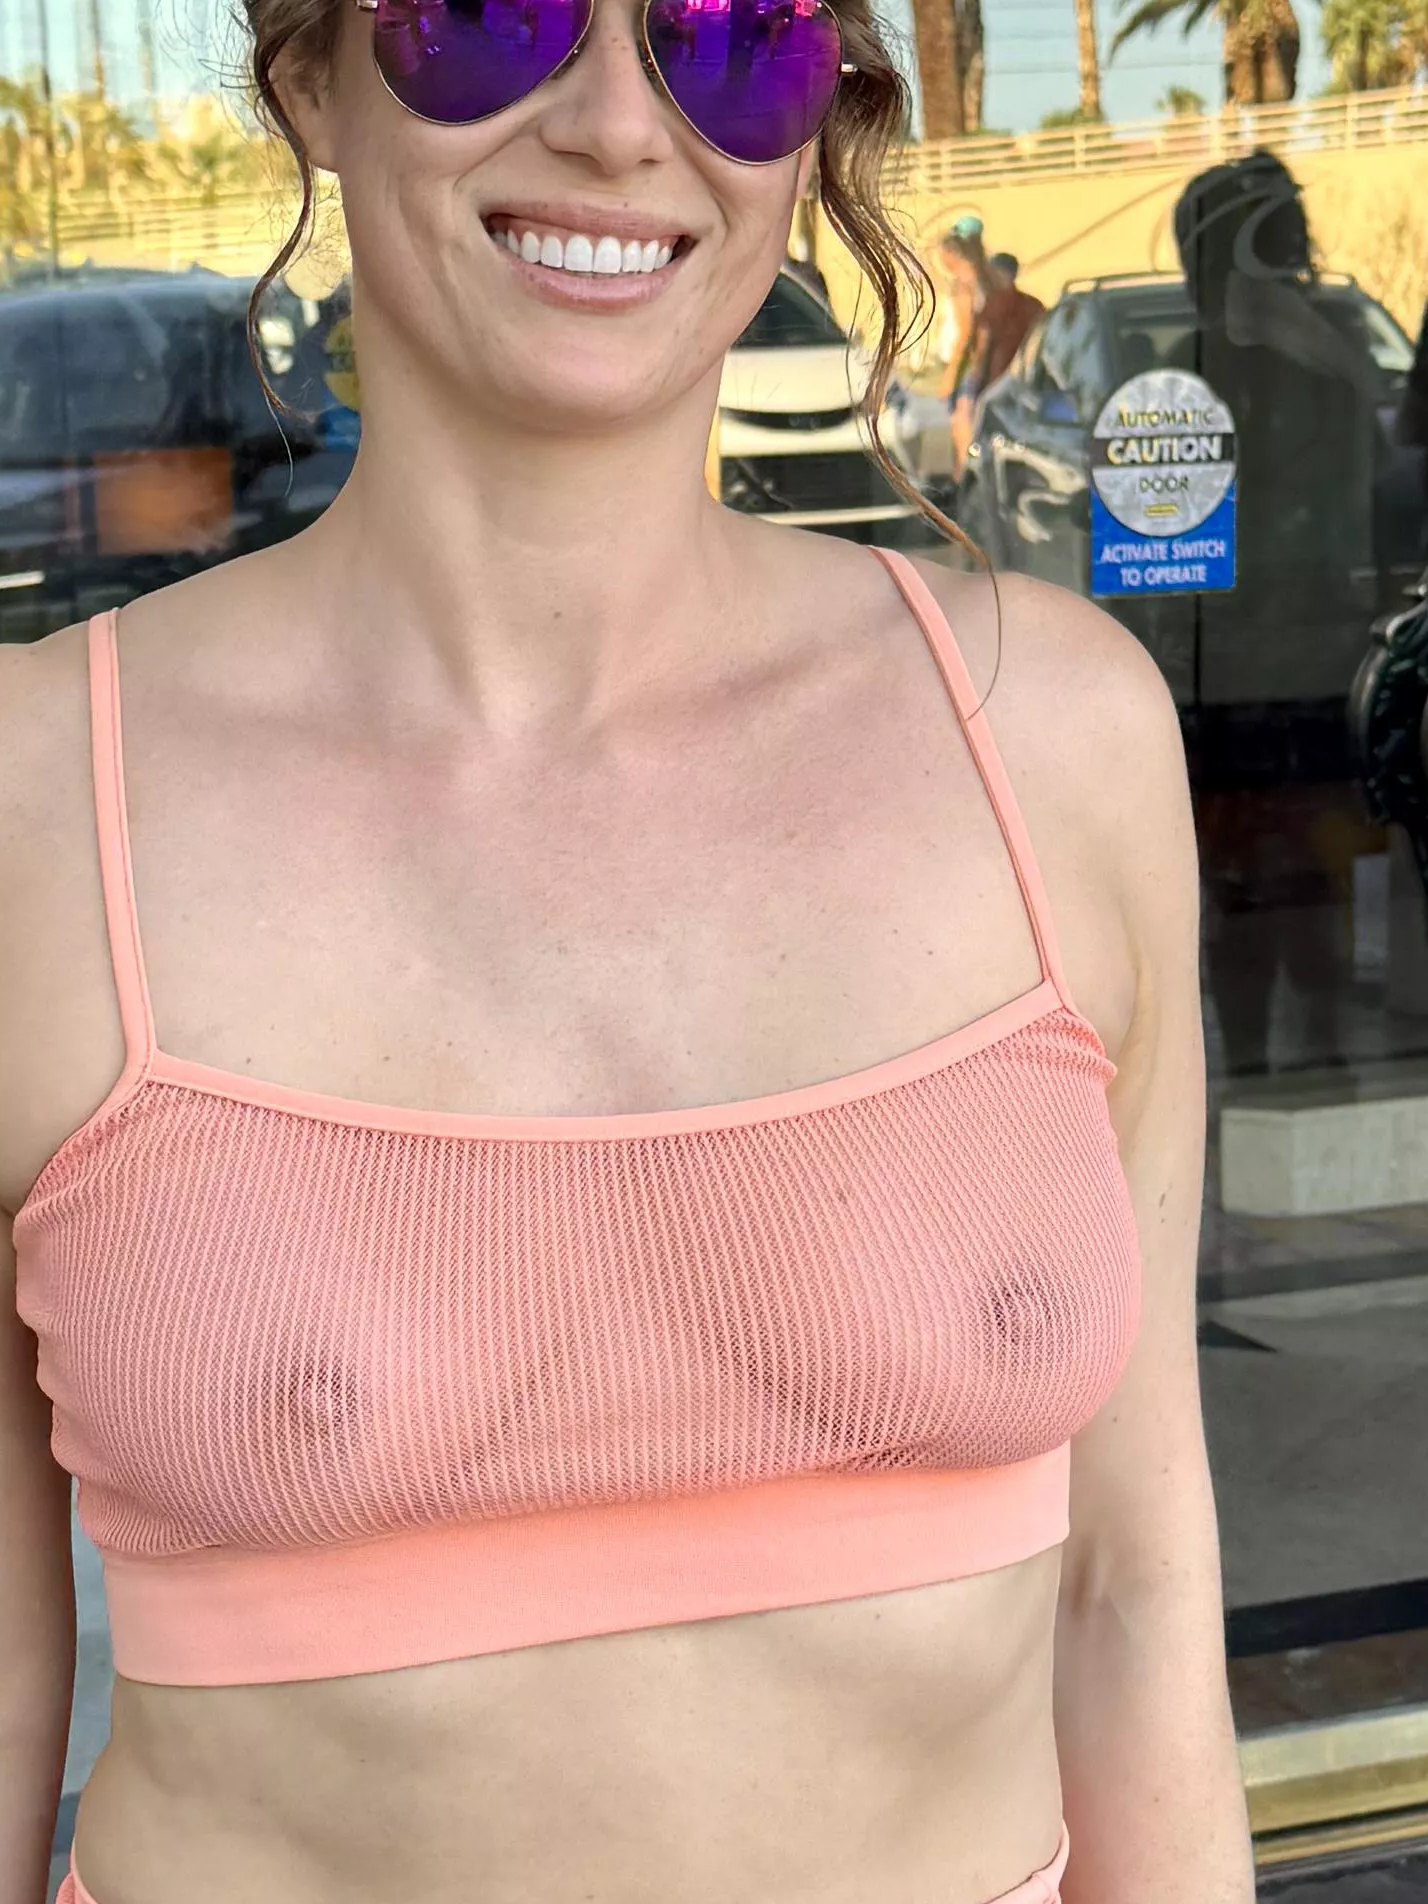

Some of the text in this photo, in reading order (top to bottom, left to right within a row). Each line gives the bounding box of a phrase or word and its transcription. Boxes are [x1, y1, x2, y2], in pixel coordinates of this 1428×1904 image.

[1117, 410, 1214, 427] AUTOMATIC
[1107, 436, 1222, 464] CAUTION
[1139, 475, 1189, 494] DOOR
[1100, 540, 1226, 563] ACTIVATE SWITCH
[1120, 565, 1206, 587] TO OPERATE
